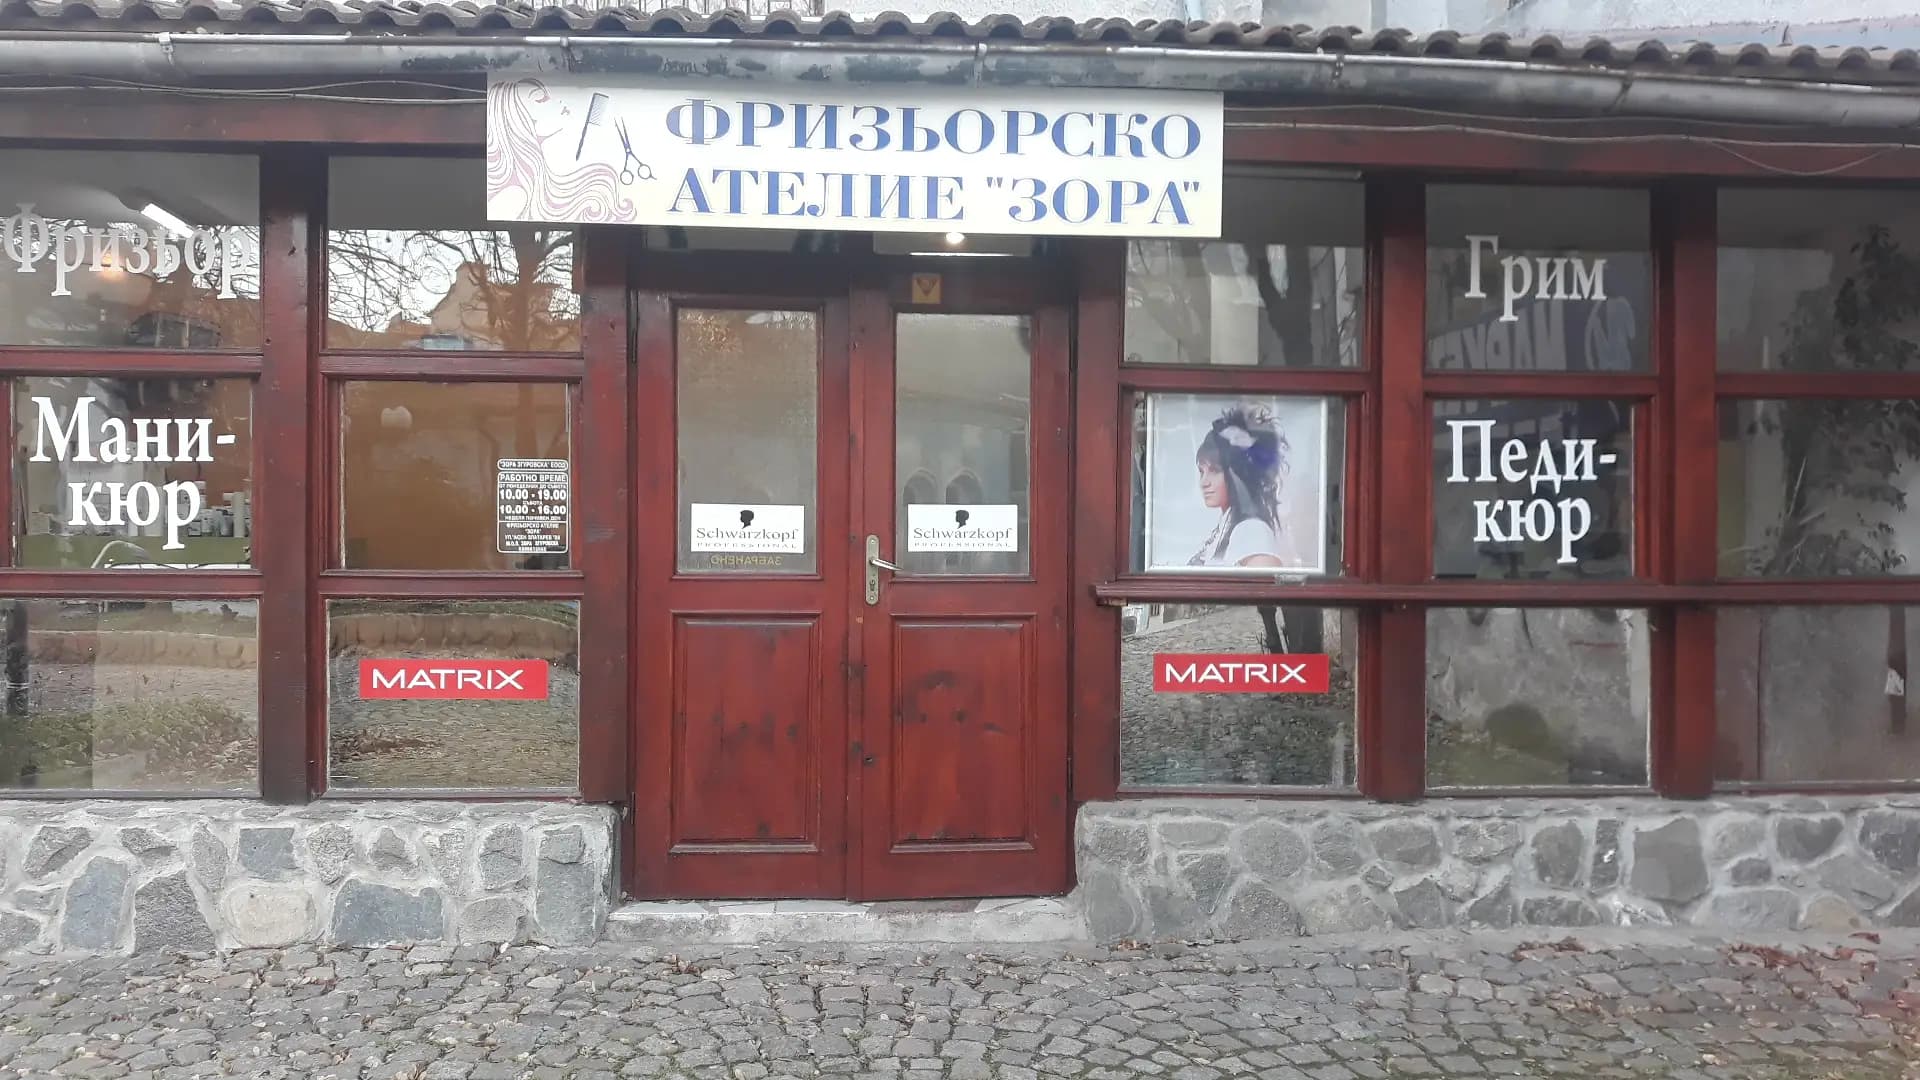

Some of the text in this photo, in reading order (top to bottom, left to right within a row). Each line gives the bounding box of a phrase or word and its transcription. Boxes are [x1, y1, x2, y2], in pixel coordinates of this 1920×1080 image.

[666, 98, 1200, 159] ФРИЗЬОРСКО
[667, 168, 1200, 225] АТЕЛИЕ "ЗОРА"
[3, 203, 251, 299] Фризьор
[1464, 235, 1607, 322] Грим
[29, 396, 236, 463] Мани-
[1446, 419, 1617, 493] Педи-
[500, 489, 528, 500] 10.00
[538, 489, 566, 500] 19.00
[539, 474, 566, 482] ВРЕМЕ
[68, 479, 201, 550] кюр
[500, 505, 528, 514] 10.00
[538, 505, 566, 515] 16.00
[696, 527, 800, 543] Schwarzkopf
[913, 527, 1013, 542] Schwarzkopf
[1473, 495, 1591, 564] кюр
[372, 669, 524, 690] MATRIX
[1165, 663, 1307, 684] MATRIX
